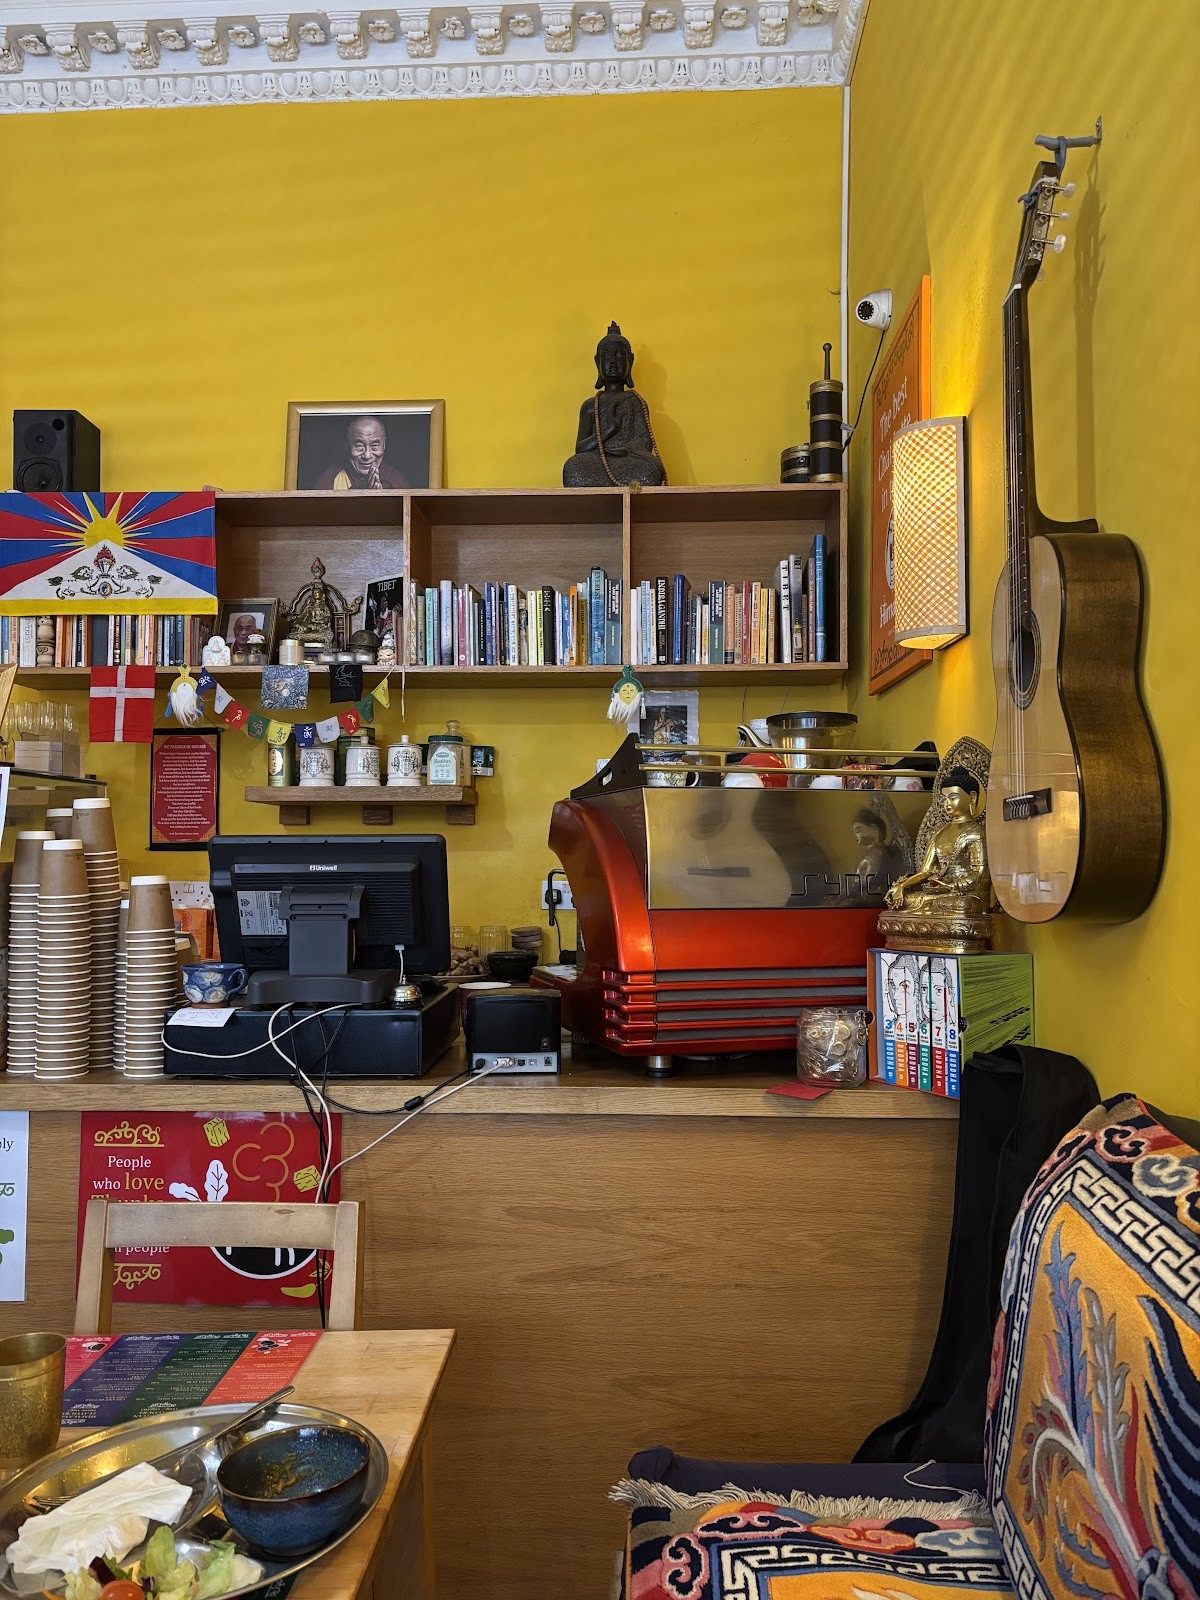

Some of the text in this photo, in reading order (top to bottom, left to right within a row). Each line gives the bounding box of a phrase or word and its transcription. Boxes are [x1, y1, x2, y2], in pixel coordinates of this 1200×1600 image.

[880, 375, 908, 443] The best
[878, 439, 892, 482] Chai
[378, 580, 397, 592] TIBET
[782, 564, 790, 611] TIBET
[658, 604, 666, 630] GANDHI
[886, 1020, 893, 1029] 3
[896, 1022, 903, 1032] 4
[908, 1023, 915, 1033] 5
[920, 1024, 927, 1034] 6
[935, 1026, 941, 1036] 7
[950, 1029, 956, 1040] 8
[108, 1156, 152, 1170] People
[93, 1172, 164, 1190] who love
